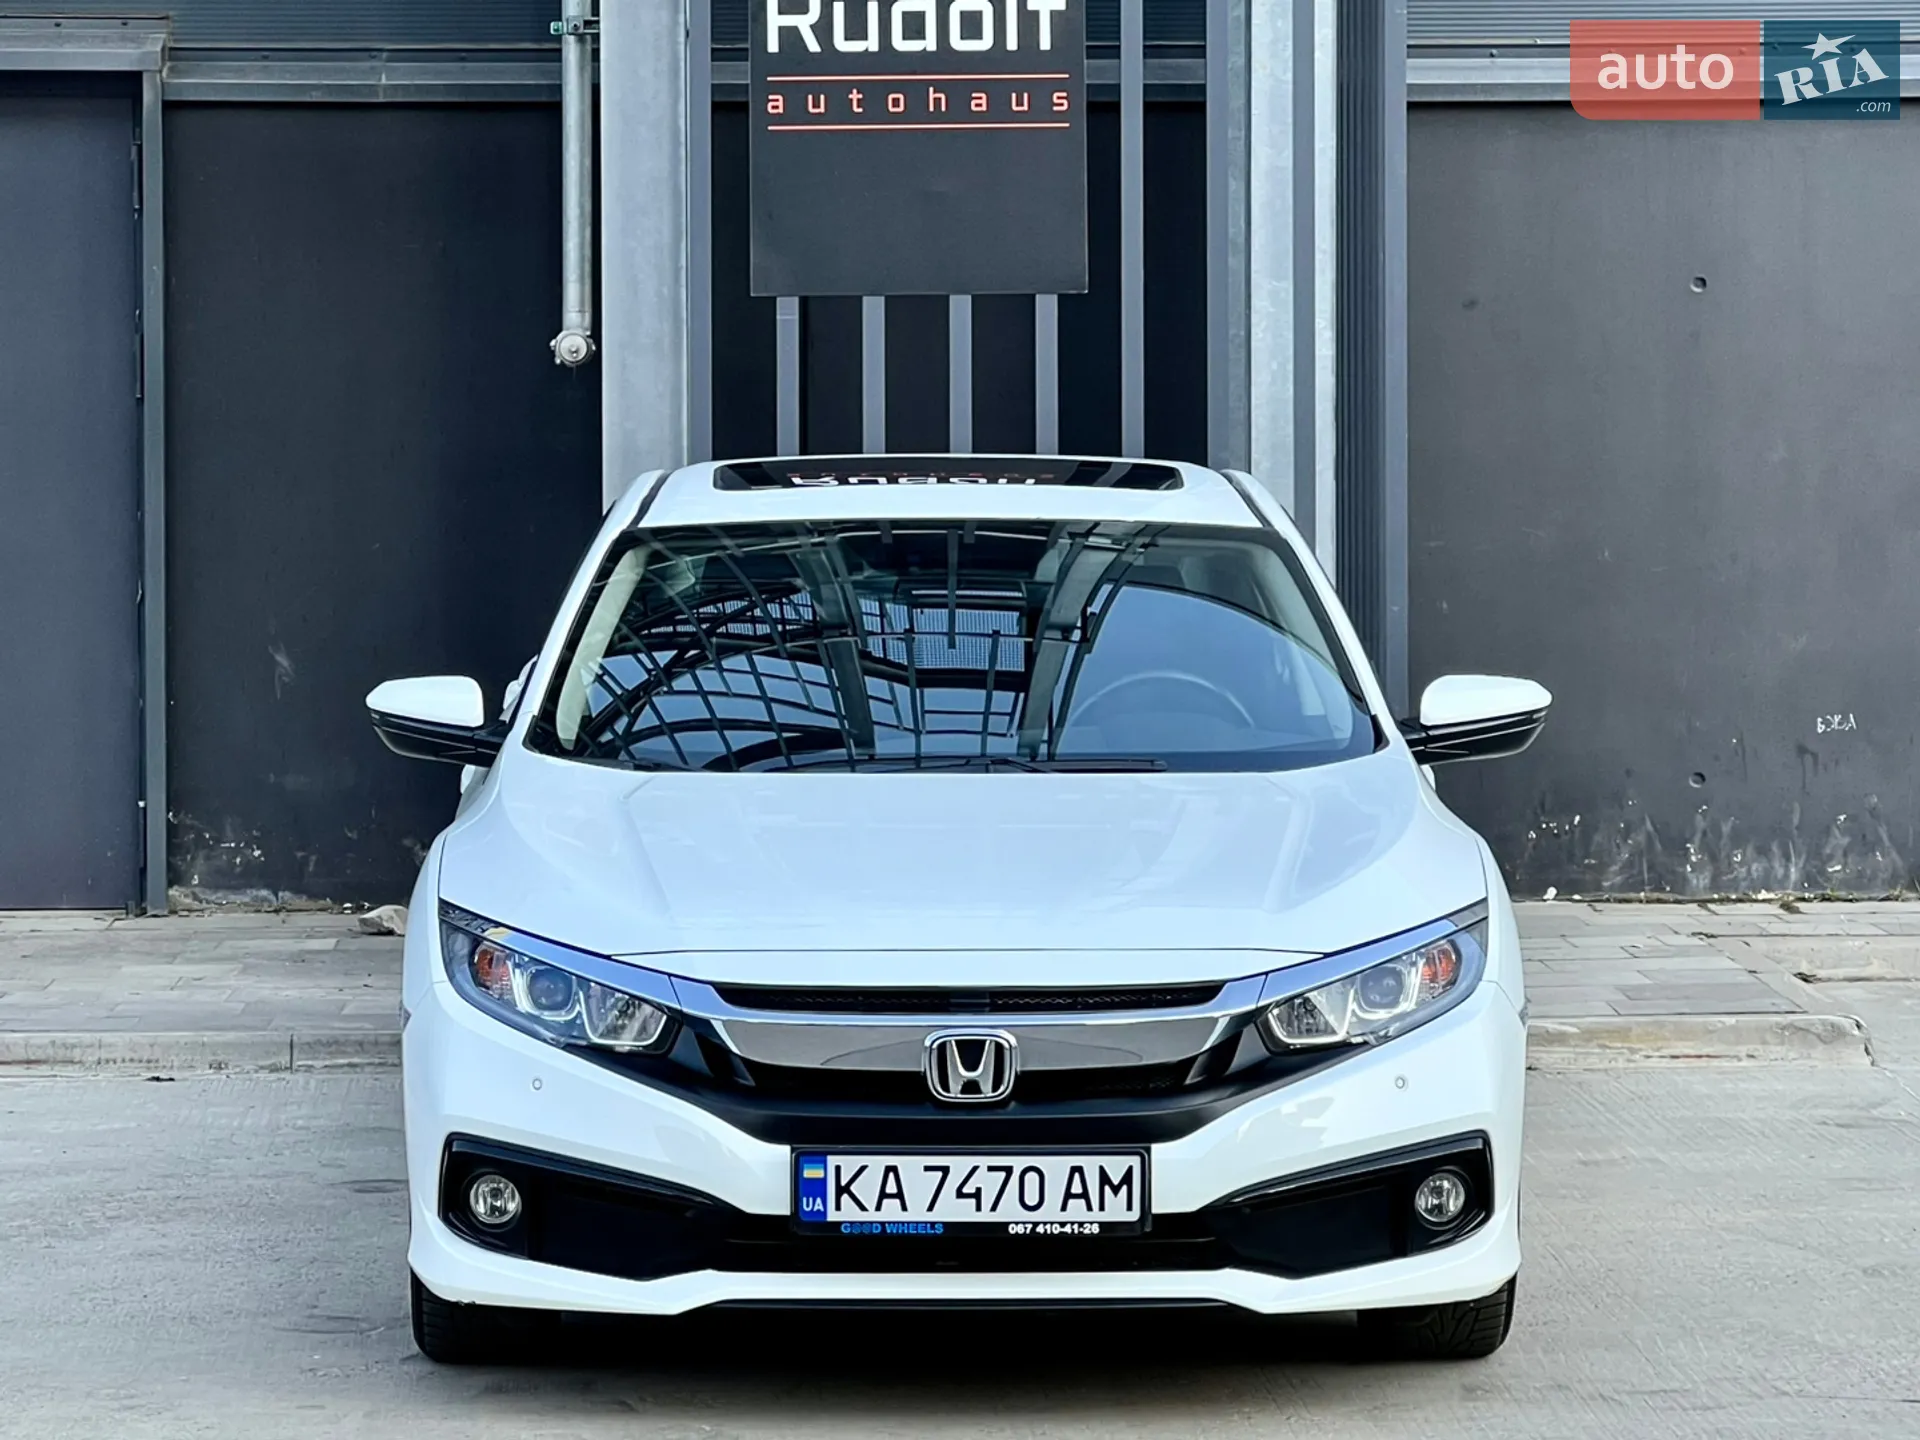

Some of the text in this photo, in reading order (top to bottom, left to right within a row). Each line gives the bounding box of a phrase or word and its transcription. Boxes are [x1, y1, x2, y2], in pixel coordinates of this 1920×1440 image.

[766, 87, 1070, 114] autohaus
[834, 1164, 1135, 1213] KA 7470 AM
[802, 1197, 825, 1213] UA
[885, 1222, 944, 1234] WHEELS
[1008, 1223, 1100, 1235] 067 410-41-26
